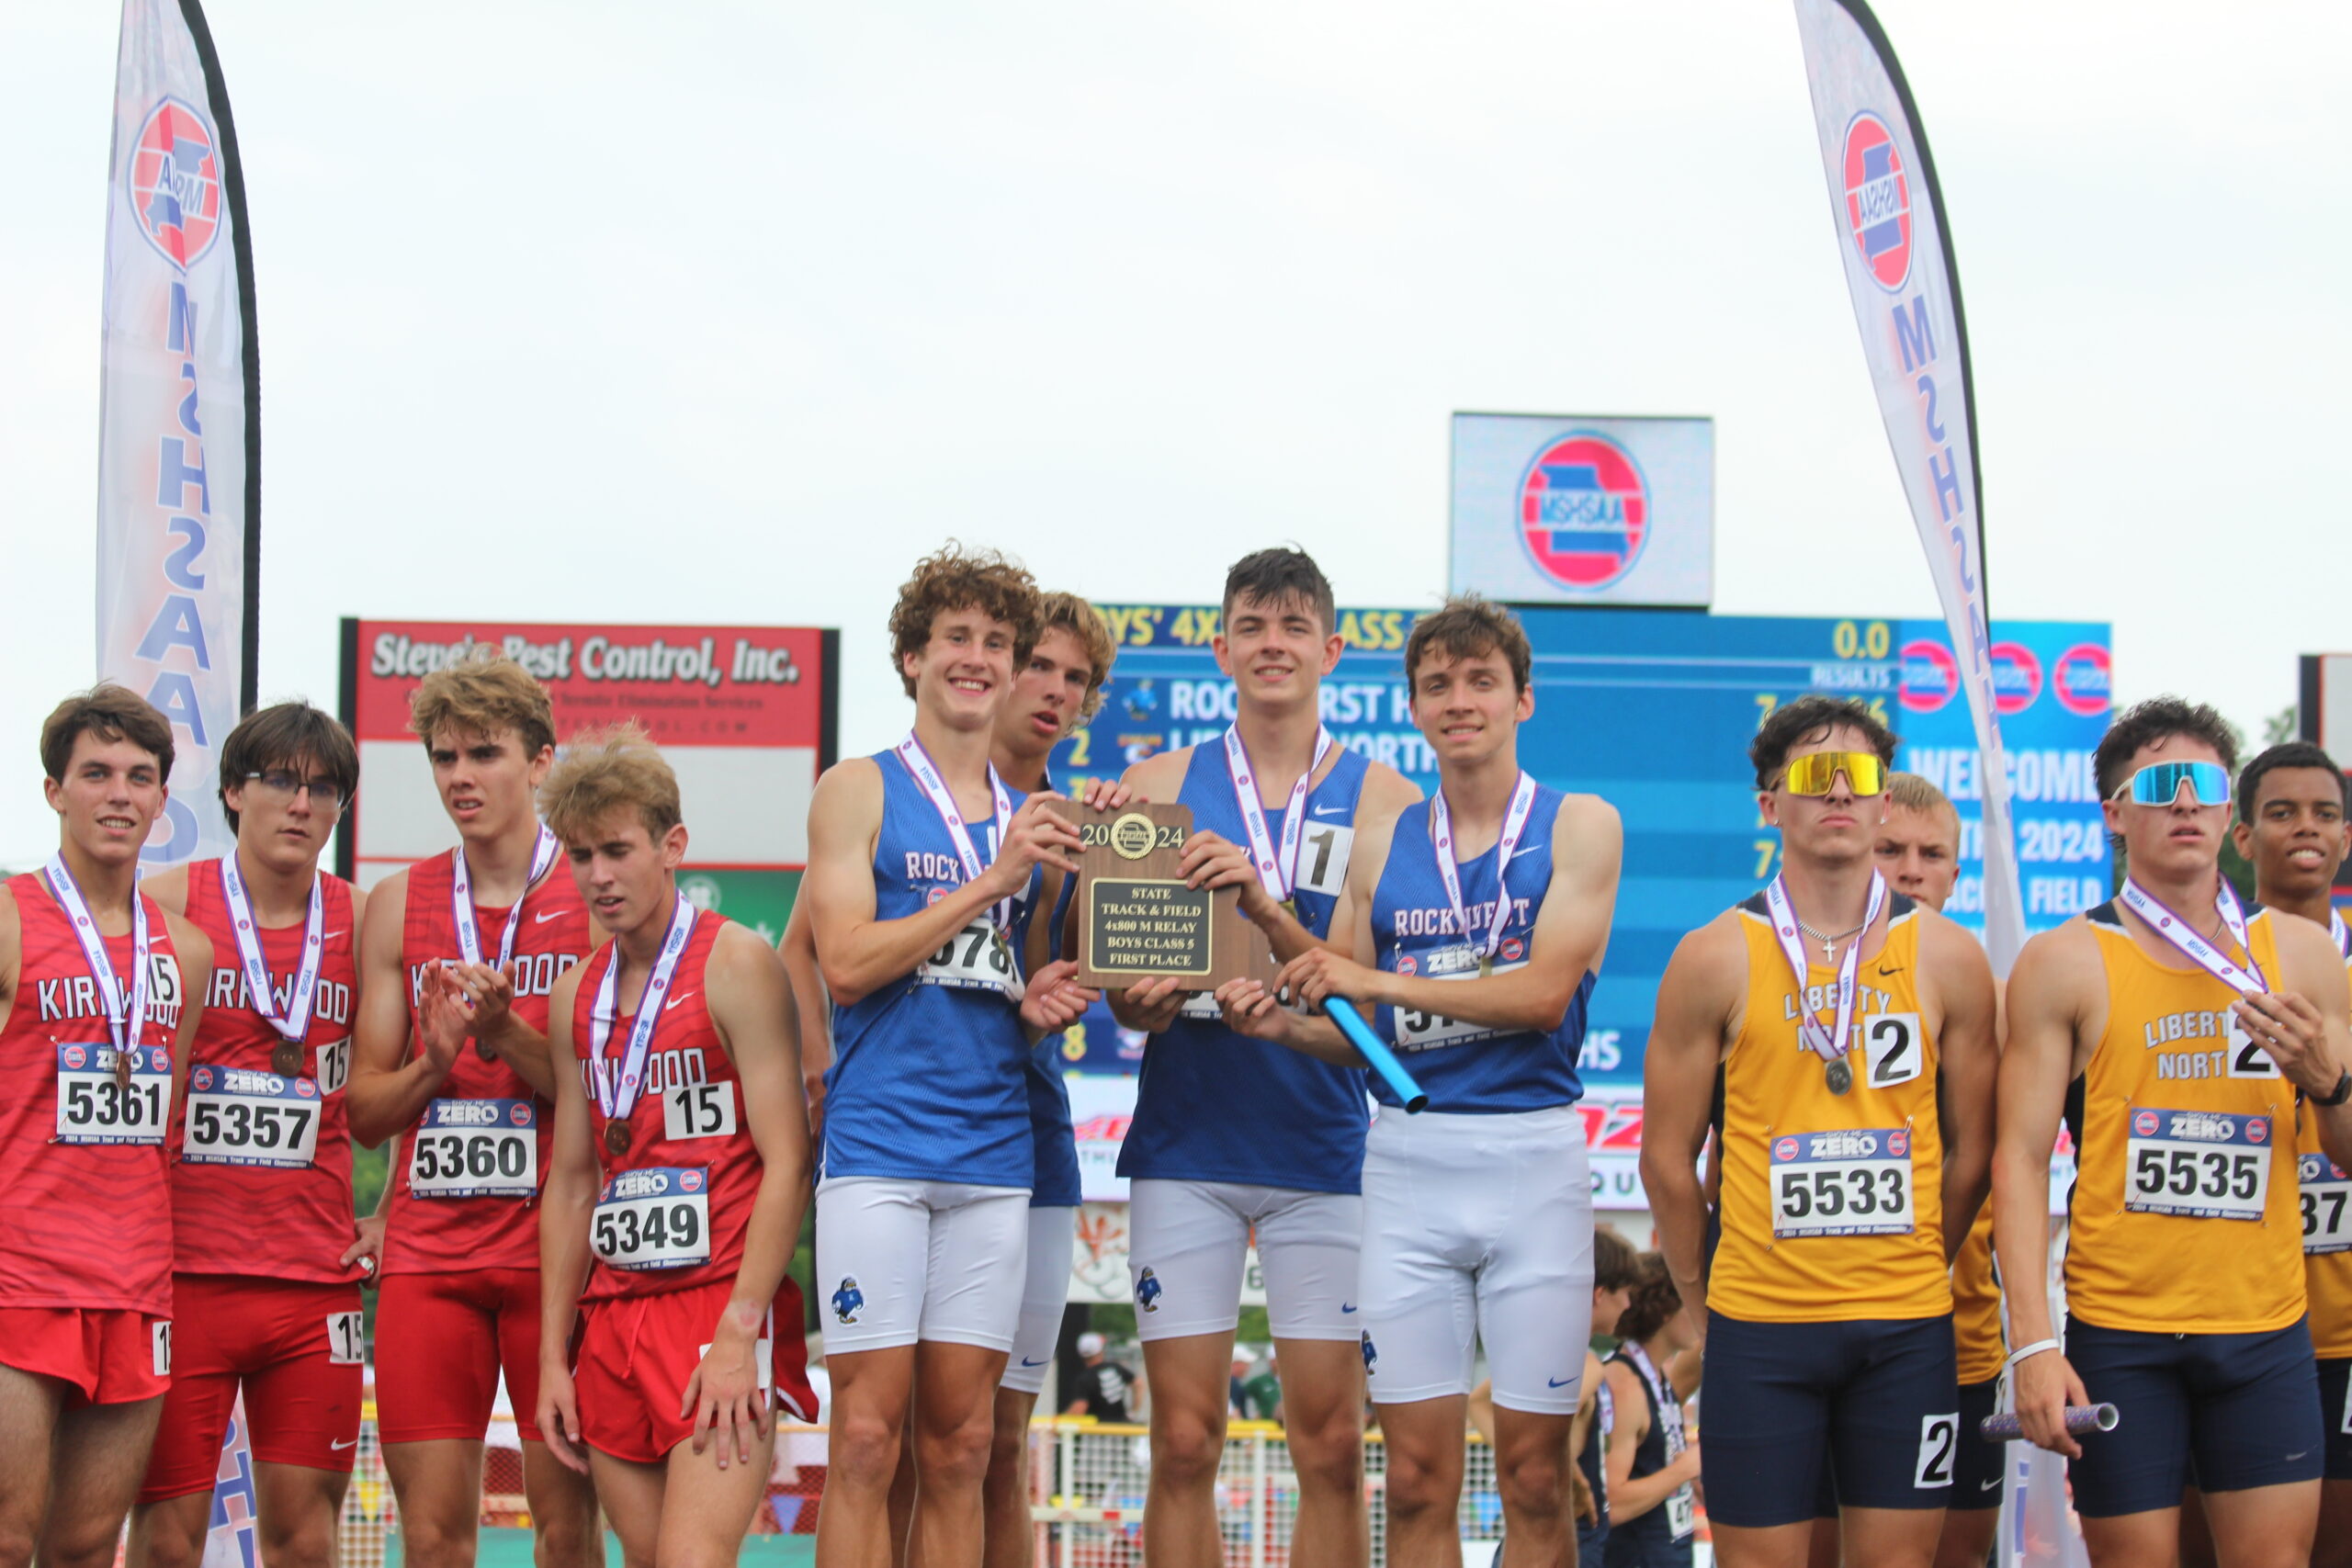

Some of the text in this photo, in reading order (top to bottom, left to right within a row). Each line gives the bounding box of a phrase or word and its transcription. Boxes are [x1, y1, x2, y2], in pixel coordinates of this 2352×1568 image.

[1340, 611, 1404, 650] ASS
[1833, 621, 1891, 660] 0.0
[502, 634, 572, 679] Pest
[579, 636, 723, 686] Control,
[730, 638, 800, 682] Inc.
[1810, 664, 1891, 689] RESULTS
[1069, 729, 1090, 766] 2
[1081, 823, 1185, 849] 20 24
[2020, 820, 2105, 863] 2024
[1307, 829, 1337, 887] 1
[1101, 902, 1202, 918] TRACK & FIELD
[1131, 886, 1172, 900] STATE
[2029, 876, 2103, 913] FIELD
[1104, 920, 1198, 934] 4x800 M RELAY
[1107, 936, 1195, 951] BOYS CLASS 5
[1109, 953, 1193, 966] FIRST PLACE
[1062, 1021, 1087, 1061] 8
[2143, 1010, 2230, 1049] LIBERT
[2233, 1012, 2271, 1073] 2
[96, 1049, 144, 1070] ZEO
[323, 1039, 348, 1091] 15
[1871, 1019, 1913, 1082] 2
[2157, 1050, 2228, 1080] NORT
[224, 1072, 284, 1095] ZERO
[67, 1080, 161, 1127] 5361
[437, 1105, 500, 1125] ZERO
[674, 1085, 723, 1135] 15
[192, 1101, 312, 1150] 5357
[2169, 1117, 2236, 1139] ZERO
[231, 1156, 244, 1165] Track
[415, 1135, 527, 1179] 5360
[1810, 1135, 1878, 1159] ZERO
[615, 1174, 669, 1198] ZERO
[1781, 1168, 1905, 1219] 5533
[2135, 1147, 2259, 1201] 5535
[596, 1203, 699, 1257] 5349
[2300, 1190, 2348, 1236] 37
[158, 1324, 171, 1371] 1
[336, 1314, 362, 1360] 15
[1920, 1420, 1954, 1484] 2
